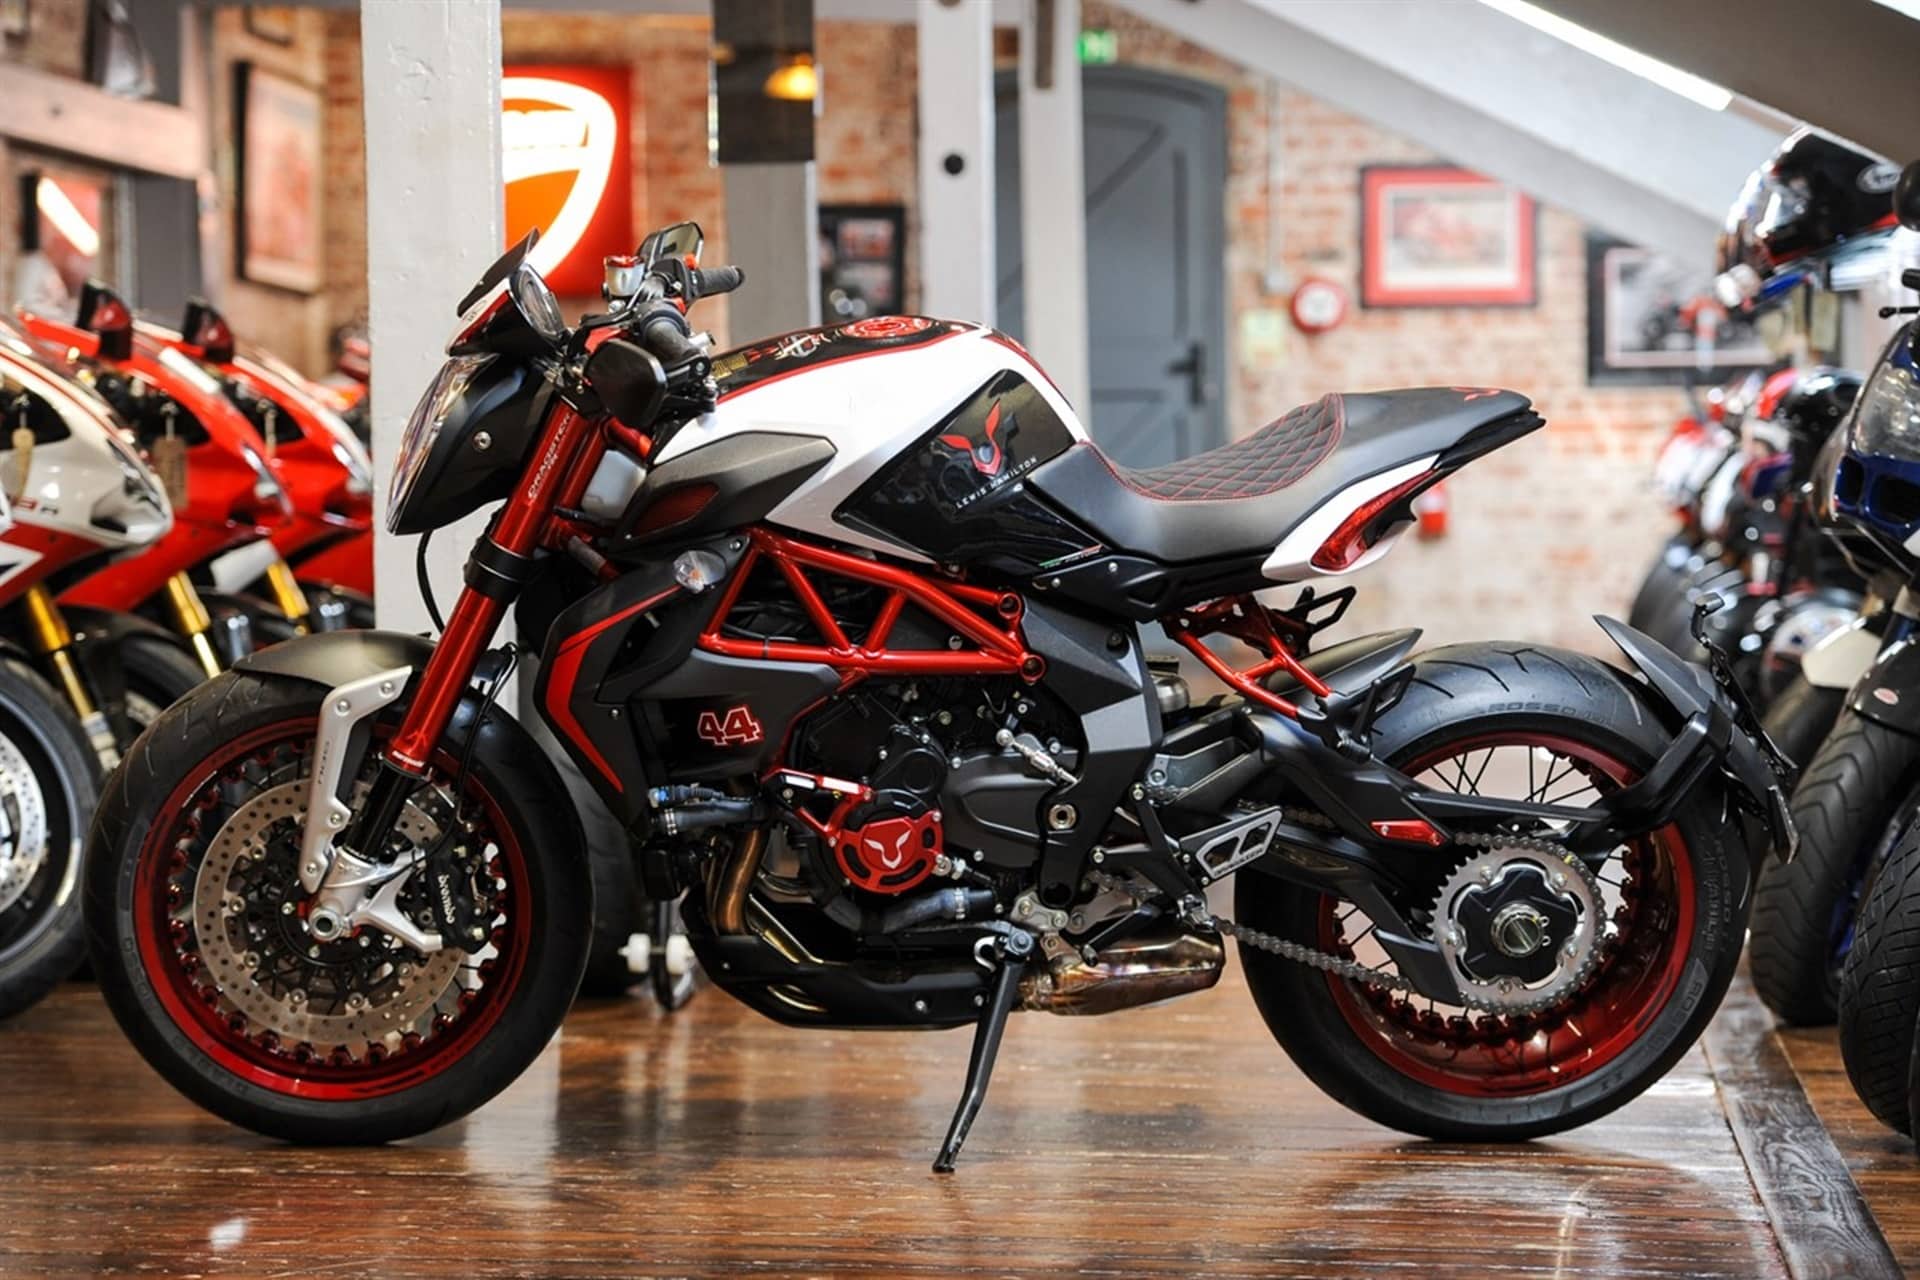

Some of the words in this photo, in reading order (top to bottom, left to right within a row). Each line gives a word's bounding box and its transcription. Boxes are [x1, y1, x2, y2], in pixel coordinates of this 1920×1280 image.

[956, 486, 987, 509] LEWIS
[990, 456, 1037, 488] HAMILTON
[696, 705, 761, 746] 44
[1486, 701, 1577, 715] ROSSO
[437, 873, 456, 924] brembo
